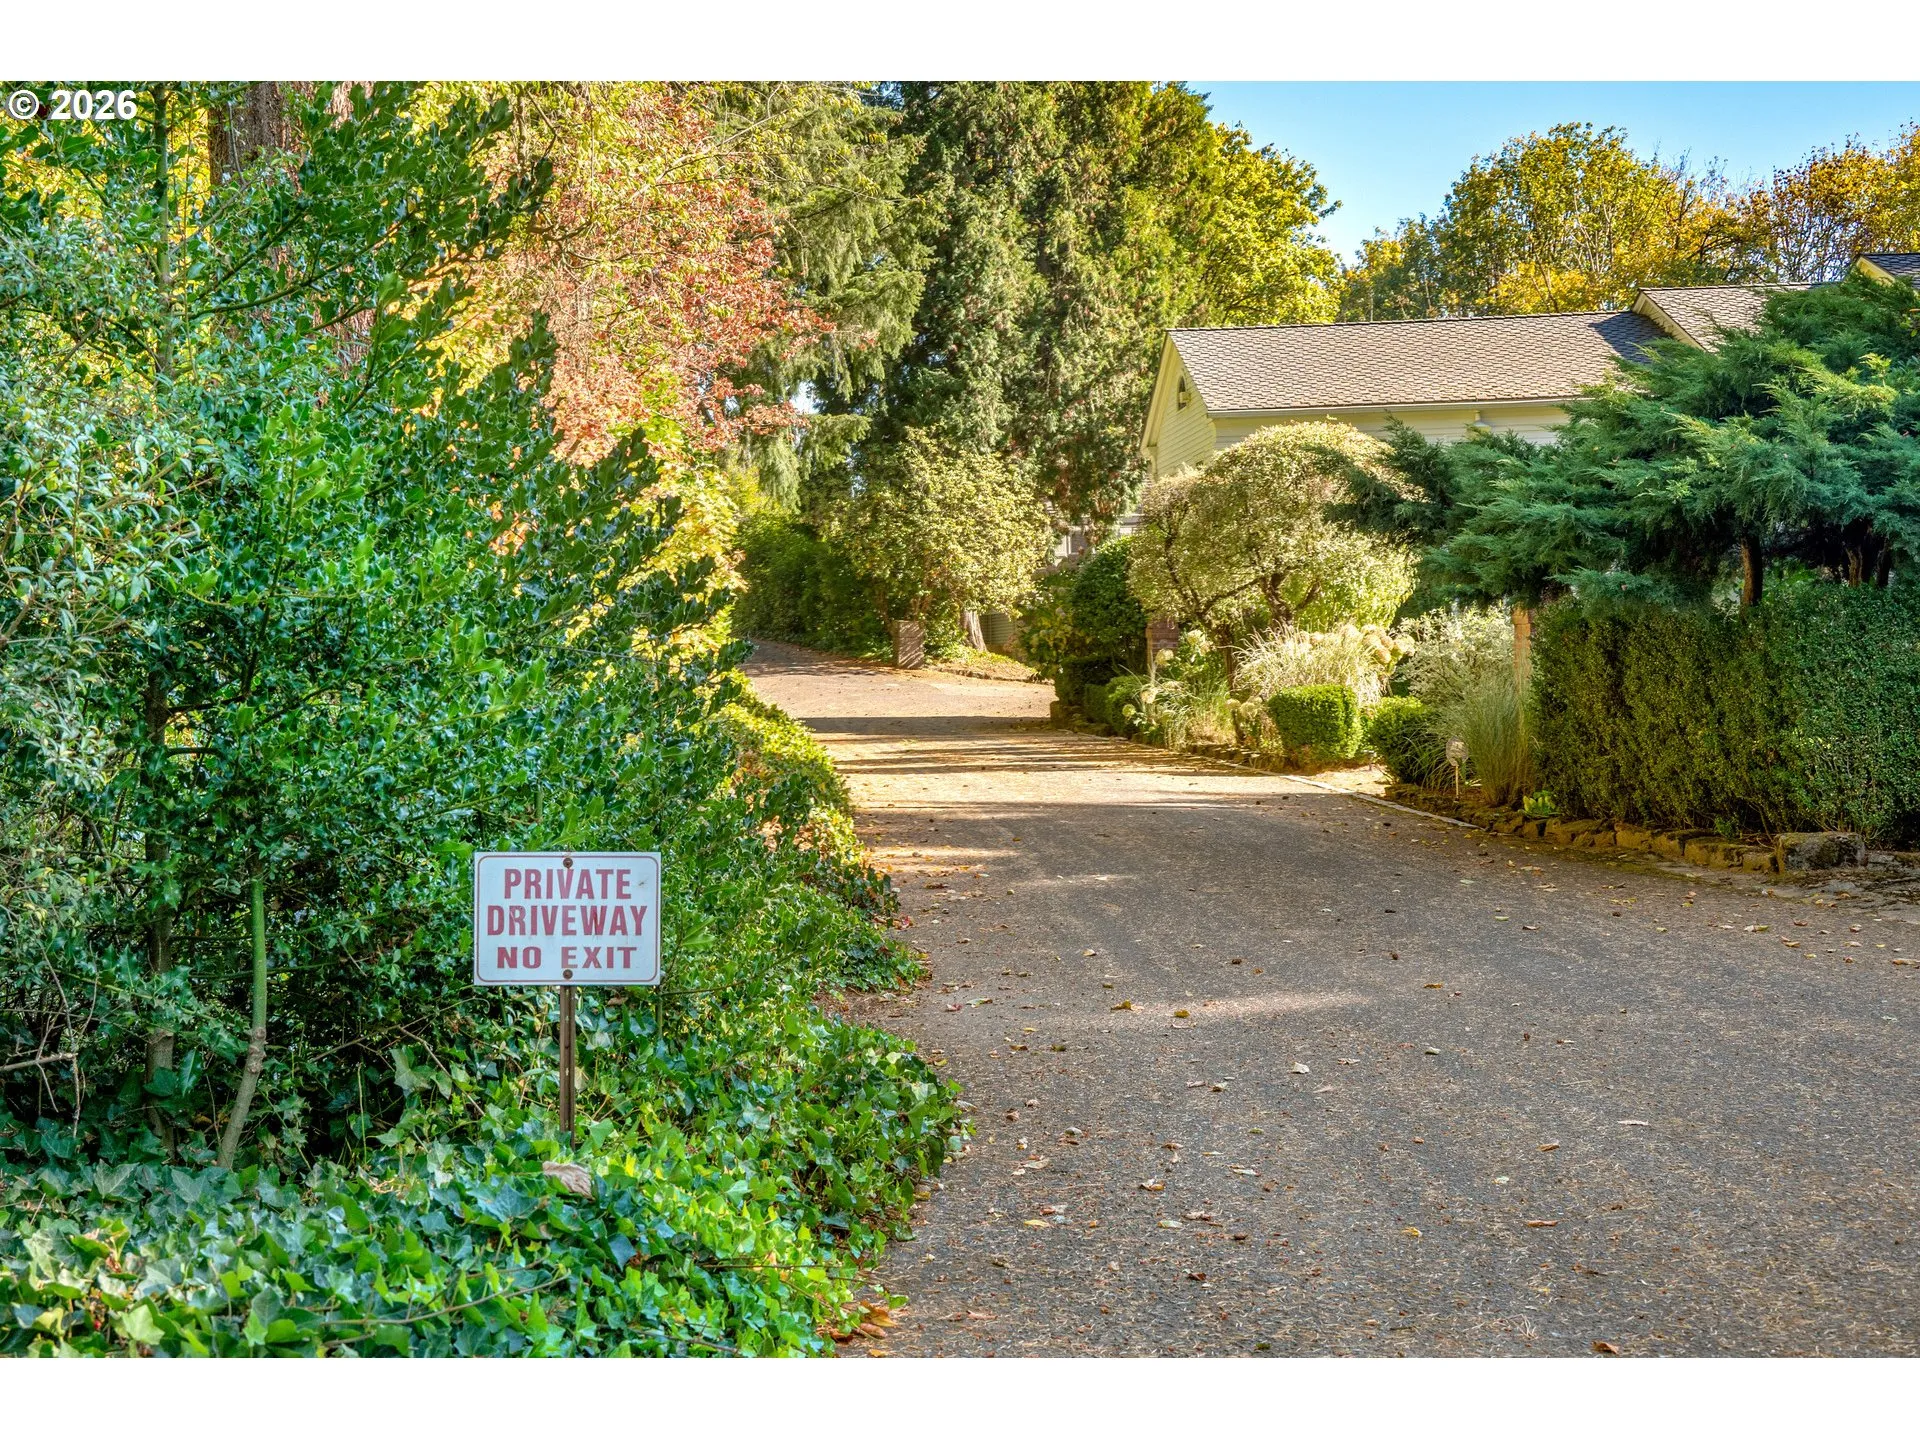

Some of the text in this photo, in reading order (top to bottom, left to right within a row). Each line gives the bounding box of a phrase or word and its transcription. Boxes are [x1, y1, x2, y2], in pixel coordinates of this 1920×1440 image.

[504, 868, 632, 900] PRIVATE
[487, 905, 648, 936] DRIVEWAY
[497, 946, 638, 969] NO EXIT
